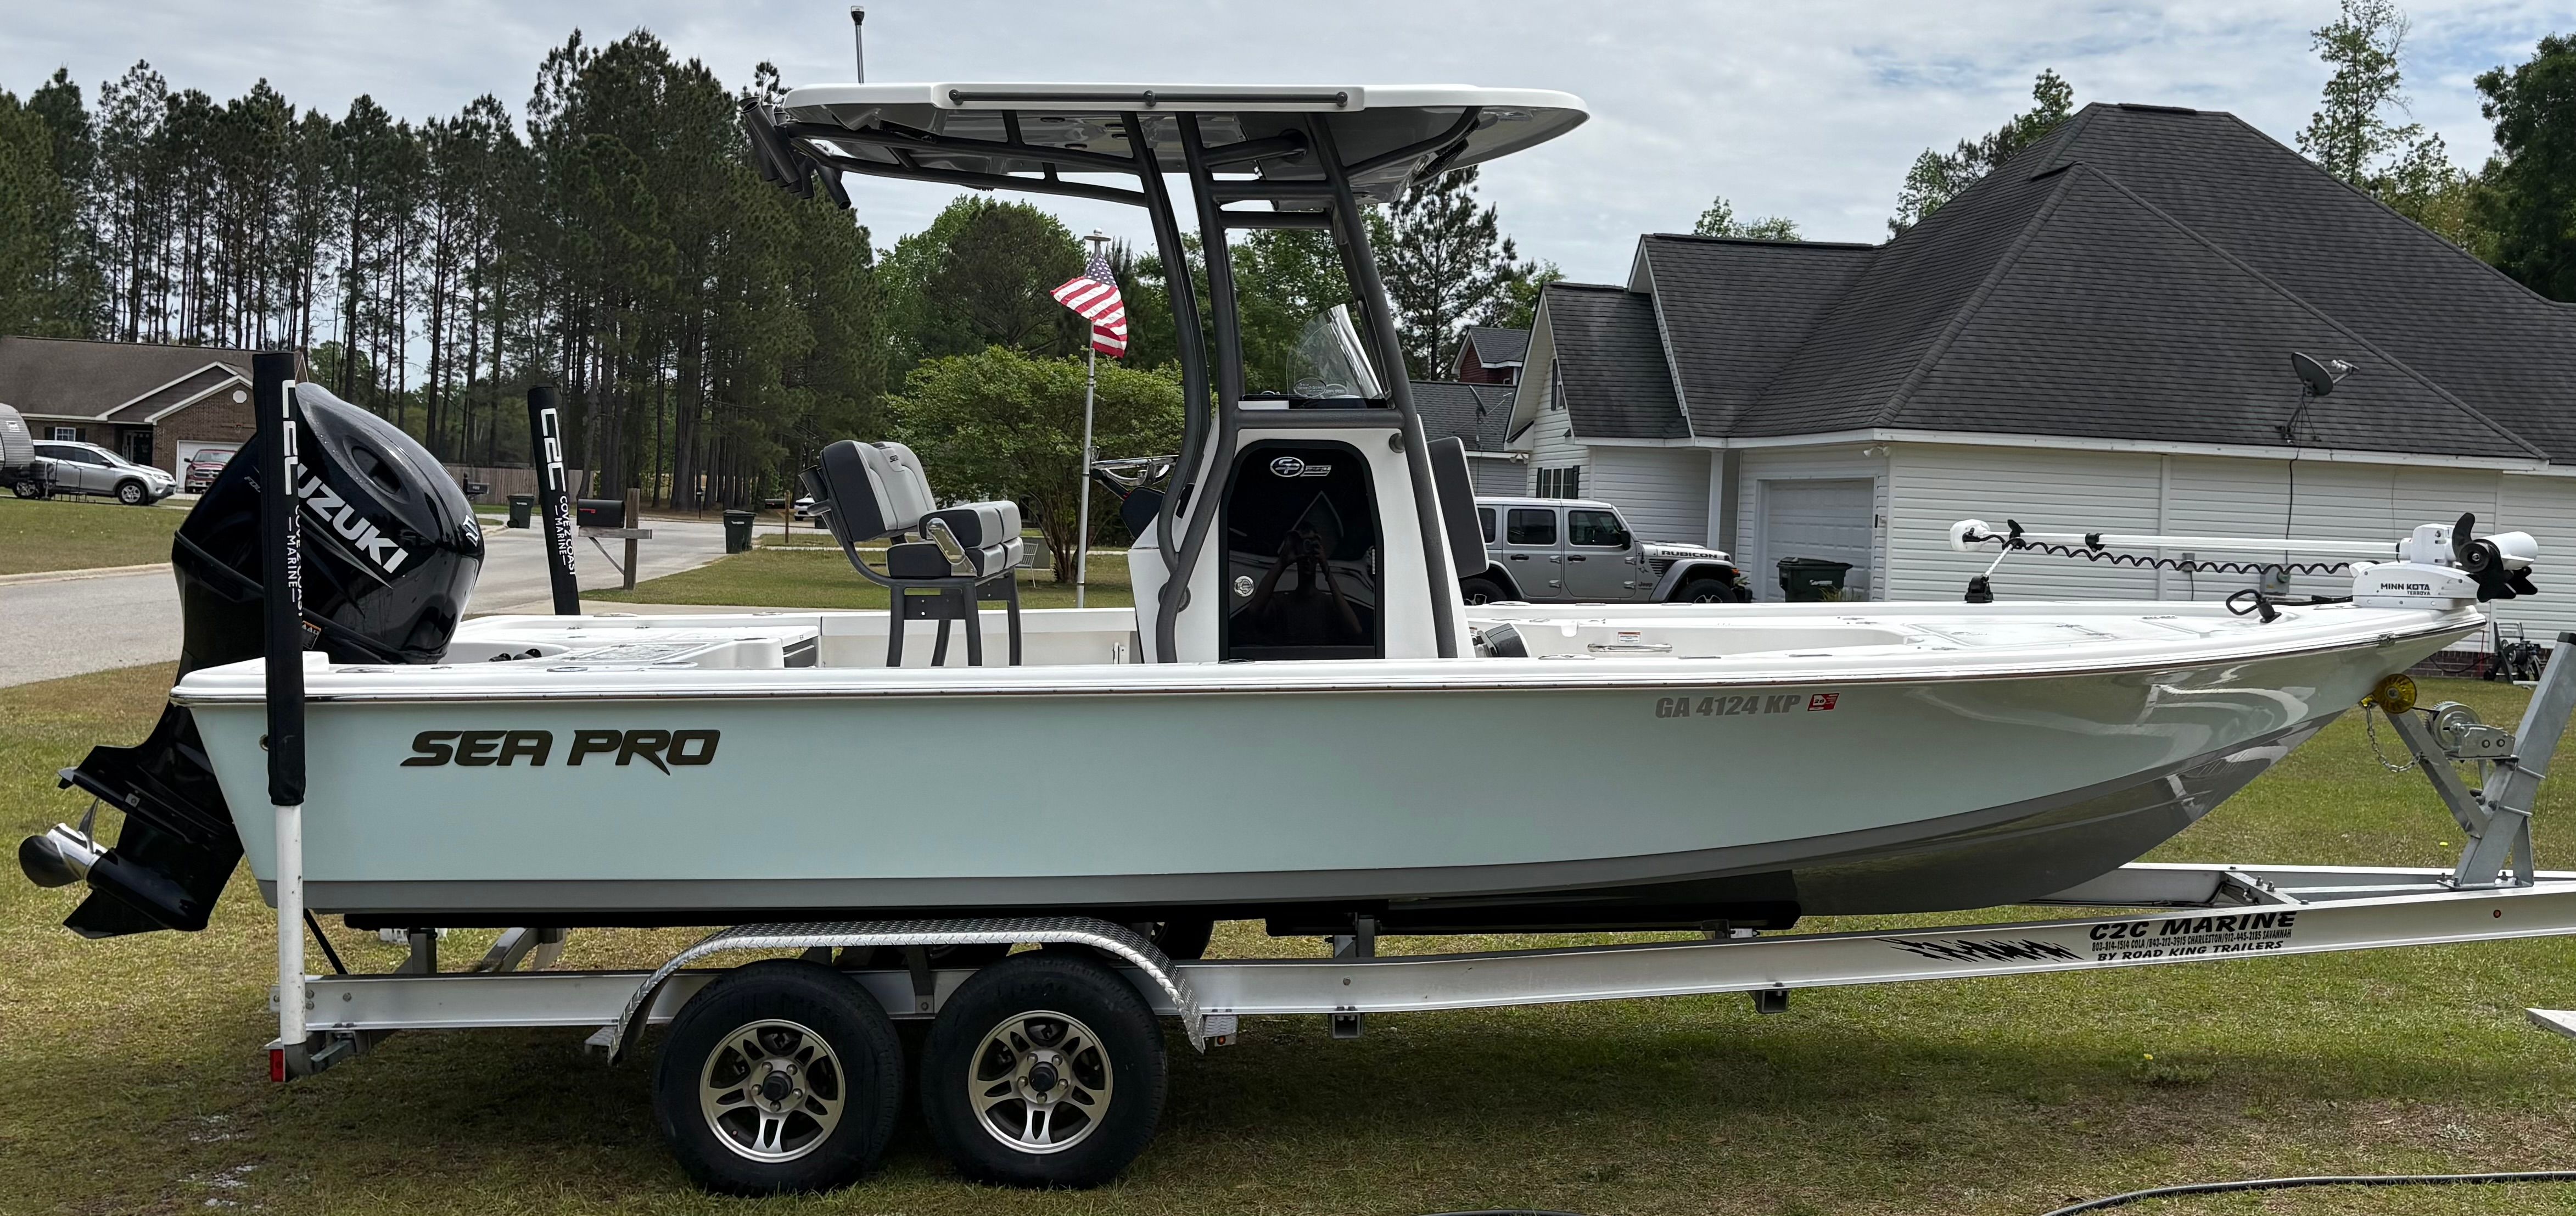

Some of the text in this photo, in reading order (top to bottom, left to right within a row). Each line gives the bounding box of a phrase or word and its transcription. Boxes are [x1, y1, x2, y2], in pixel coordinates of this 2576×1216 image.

[541, 408, 567, 492] C2C
[298, 462, 408, 573] UZUKI
[560, 495, 570, 527] COVE
[555, 517, 567, 555] MARINE
[287, 535, 298, 588] MARINE
[1655, 698, 1690, 718] GA
[1696, 695, 1760, 716] 4124
[1764, 695, 1801, 714] KP
[400, 729, 720, 776] SEA PRO
[2090, 911, 2297, 940] C2C MARINE
[2131, 939, 2144, 949] COLA
[2263, 929, 2292, 940] SAVANNAH
[2098, 941, 2283, 961] BY ROAD KING TRAILERS
